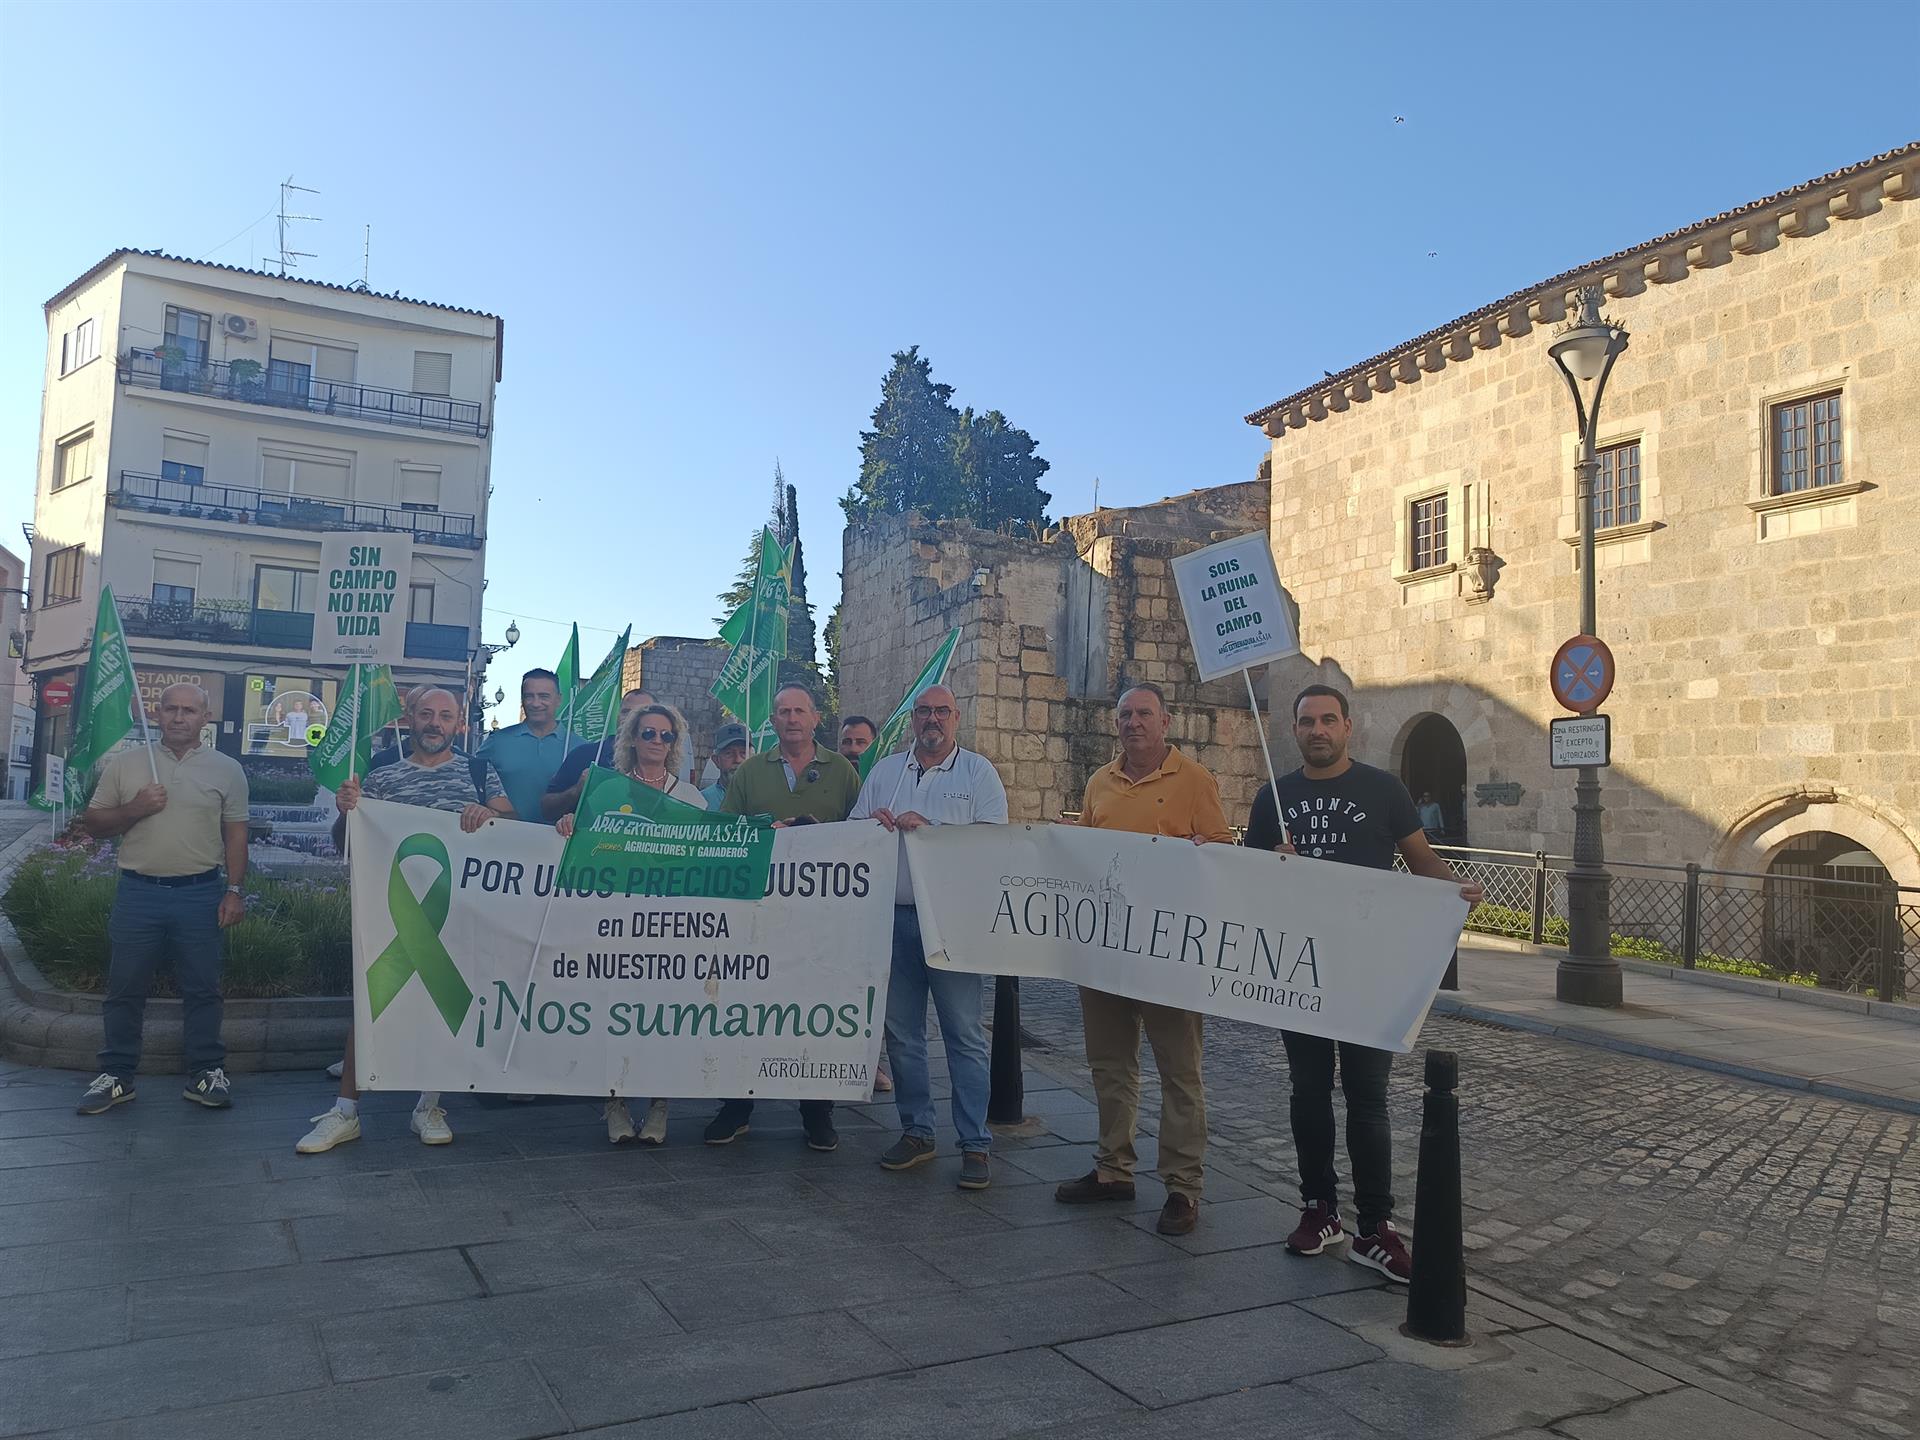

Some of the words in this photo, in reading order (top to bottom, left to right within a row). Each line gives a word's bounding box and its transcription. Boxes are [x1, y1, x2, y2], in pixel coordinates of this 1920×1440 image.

[349, 546, 381, 567] SIN
[1208, 558, 1240, 579] SOIS
[329, 569, 397, 590] CAMPO
[1201, 588, 1218, 602] LA
[1218, 573, 1259, 597] RUINA
[327, 592, 354, 613] NO
[357, 592, 395, 613] HAY
[1224, 596, 1248, 614] DEL
[336, 615, 381, 636] VIDA
[1216, 611, 1263, 637] CAMPO
[136, 672, 200, 685] STANCO
[1552, 727, 1567, 735] ZONA
[1568, 724, 1604, 734] RESTRINGIDA
[1566, 738, 1593, 747] EXCEPTO
[1560, 751, 1599, 760] AUTORIZADOS
[1310, 815, 1329, 829] 06
[624, 821, 710, 842] EXTREMADURA
[709, 823, 760, 847] ASAJA
[1292, 832, 1347, 845] CANADA
[624, 840, 686, 857] AGRICULTORES
[689, 845, 695, 857] Y
[697, 845, 749, 858] GANADEROS
[460, 857, 524, 895] POR
[533, 864, 617, 898] UNOS
[625, 864, 752, 899] PRECIOS
[763, 862, 870, 898] JUSTOS
[999, 875, 1095, 895] COOPERATIVA
[597, 917, 624, 938] en
[632, 912, 729, 939] DEFENSA
[989, 890, 1324, 990] AGROLLERENA
[552, 952, 578, 979] de
[586, 953, 686, 980] NUESTRO
[693, 954, 770, 981] CAMPO
[1207, 974, 1220, 997] y
[1231, 979, 1324, 1013] comarca
[476, 980, 591, 1048] ¡Nos
[608, 986, 875, 1038] sumamos!
[758, 1062, 868, 1080] AGROLLERENA
